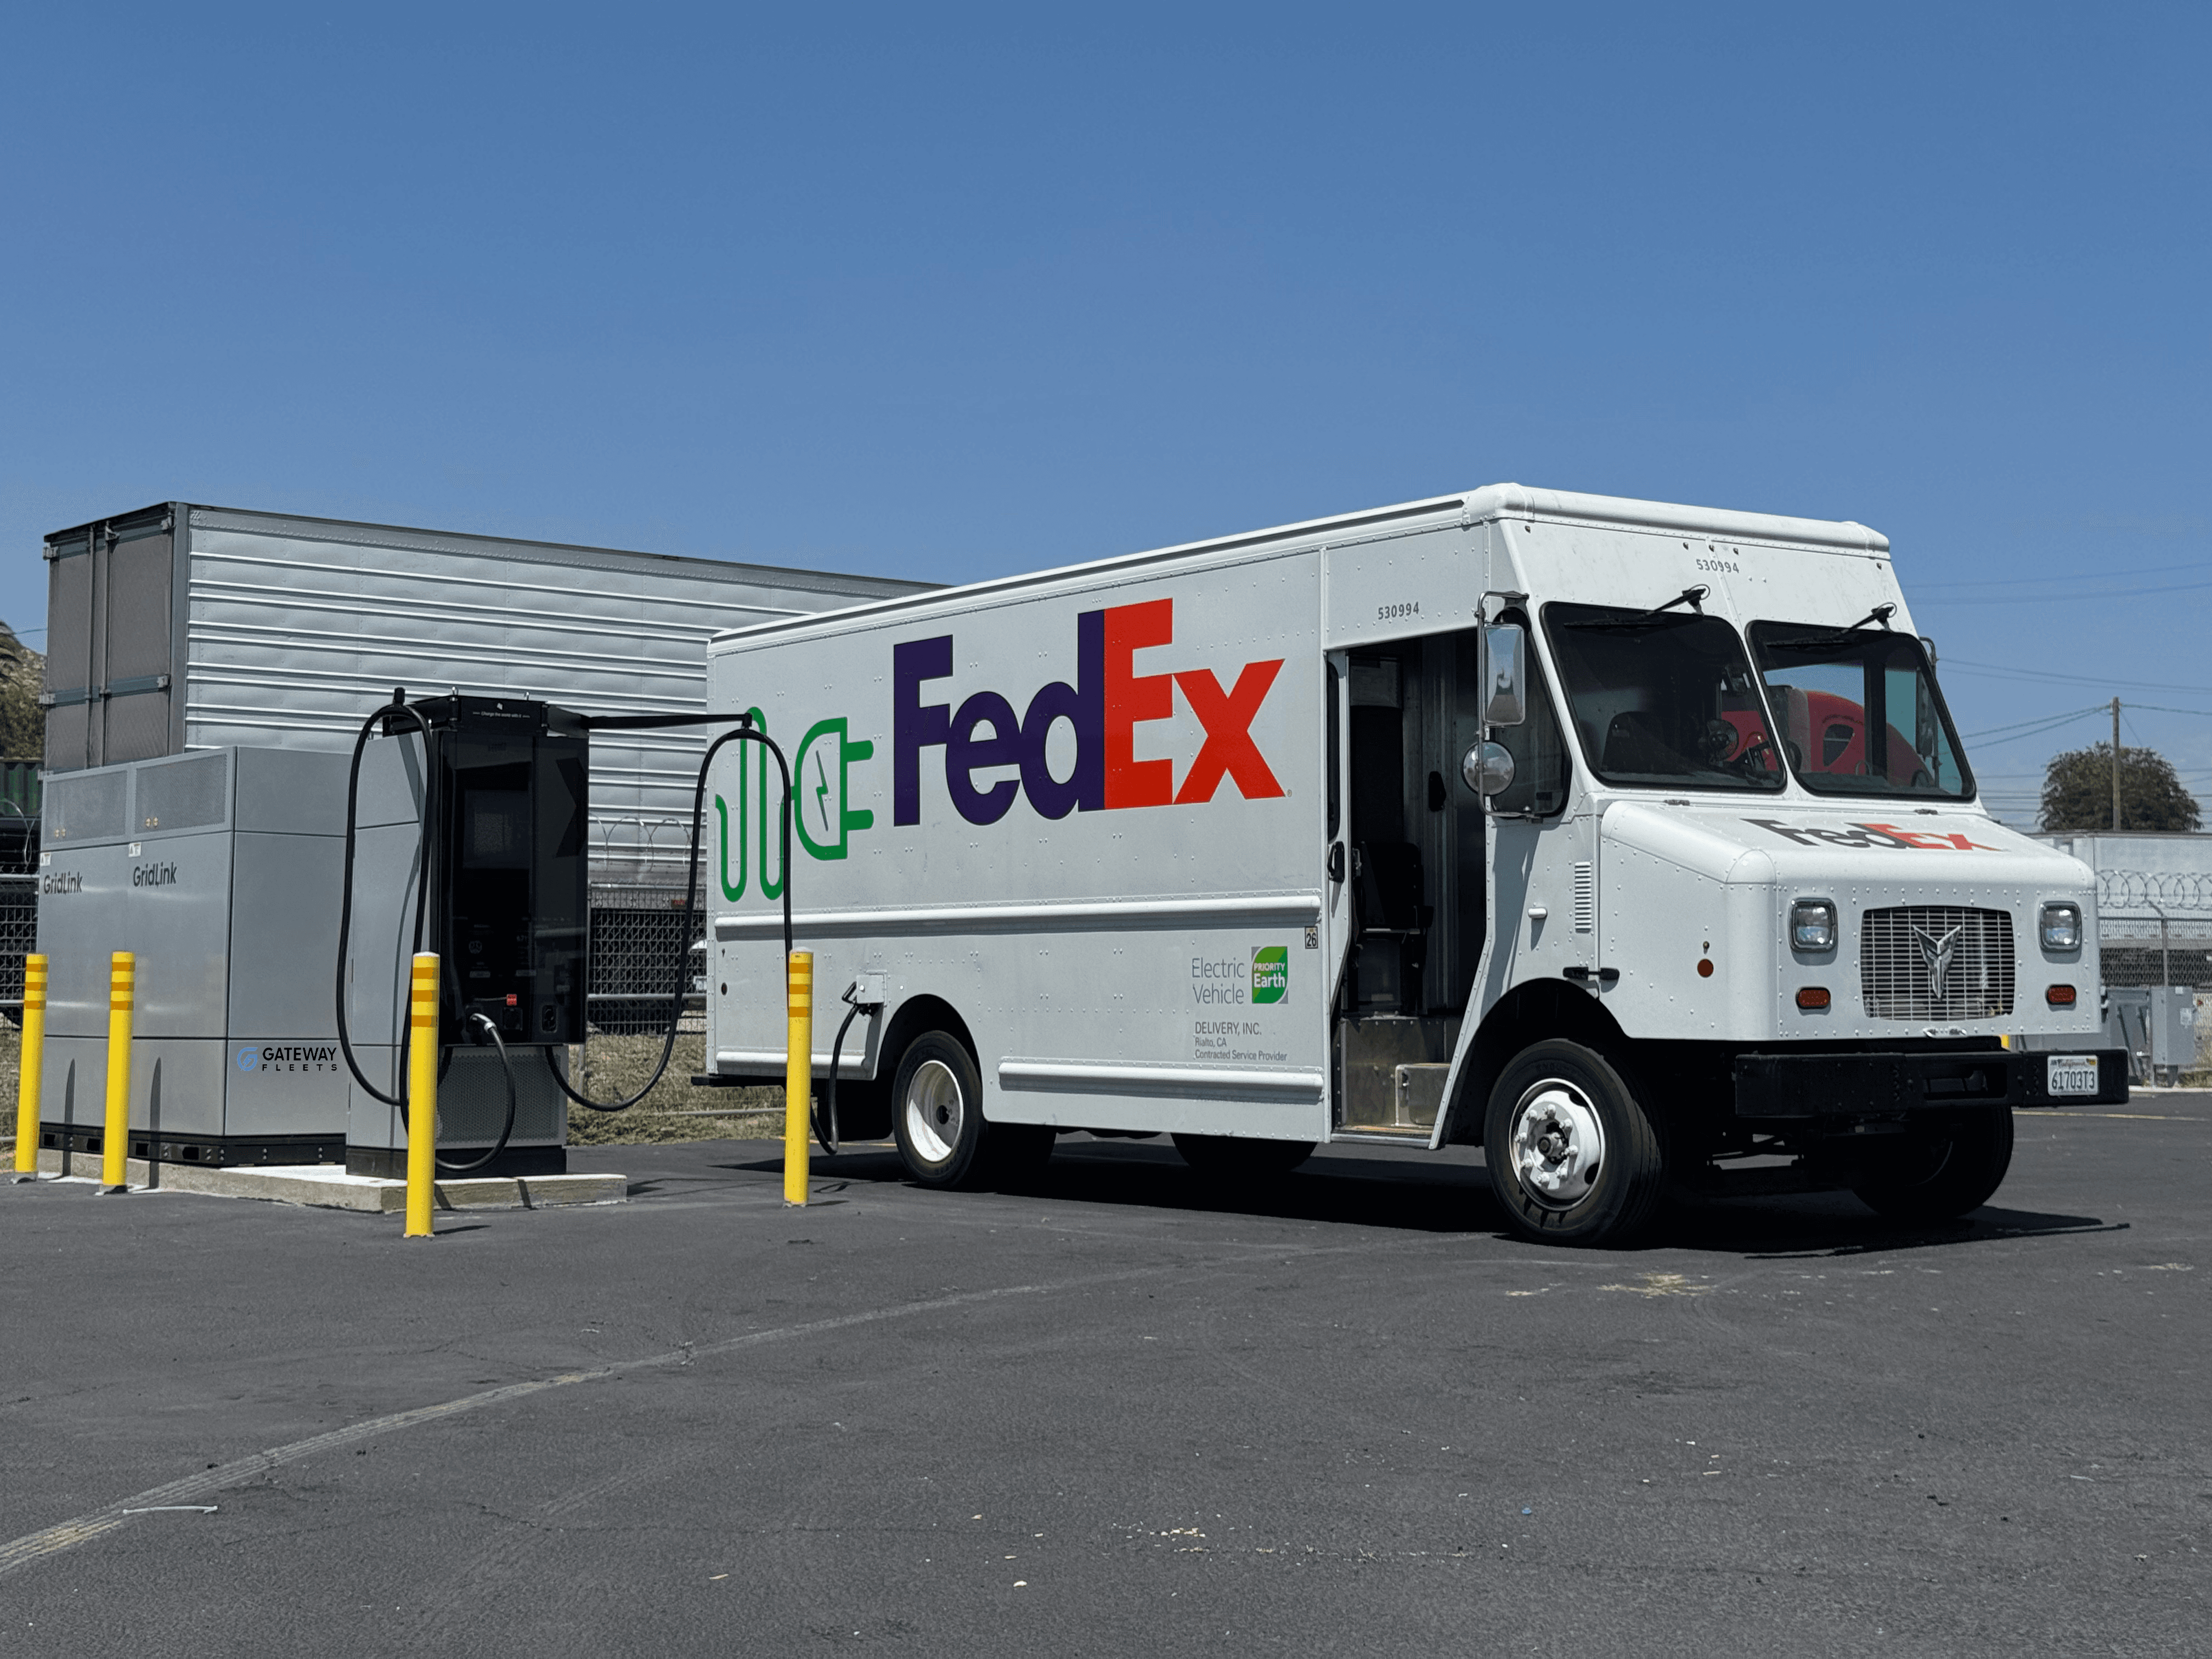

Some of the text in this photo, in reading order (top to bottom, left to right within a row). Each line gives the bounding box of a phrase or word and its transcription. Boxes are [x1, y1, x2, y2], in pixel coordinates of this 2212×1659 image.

[1696, 558, 1740, 574] 530994
[1378, 602, 1420, 620] 530994
[893, 598, 1285, 826] FedEx
[1741, 819, 2007, 851] FedEx
[43, 871, 83, 895] GridLink
[133, 861, 177, 888] GridLink
[1306, 933, 1317, 947] 26
[1192, 957, 1245, 978] Electric
[1254, 962, 1286, 971] PRIORITY
[1254, 973, 1285, 988] Earth
[1192, 983, 1244, 1005] Vehicle
[1195, 1022, 1262, 1036] DELIVERY, INC.
[1195, 1037, 1227, 1047] Rialto, CA
[262, 1047, 337, 1061] GATEWAY
[1195, 1049, 1288, 1061] Contracted Service Provider
[2052, 1071, 2095, 1090] 61703T3
